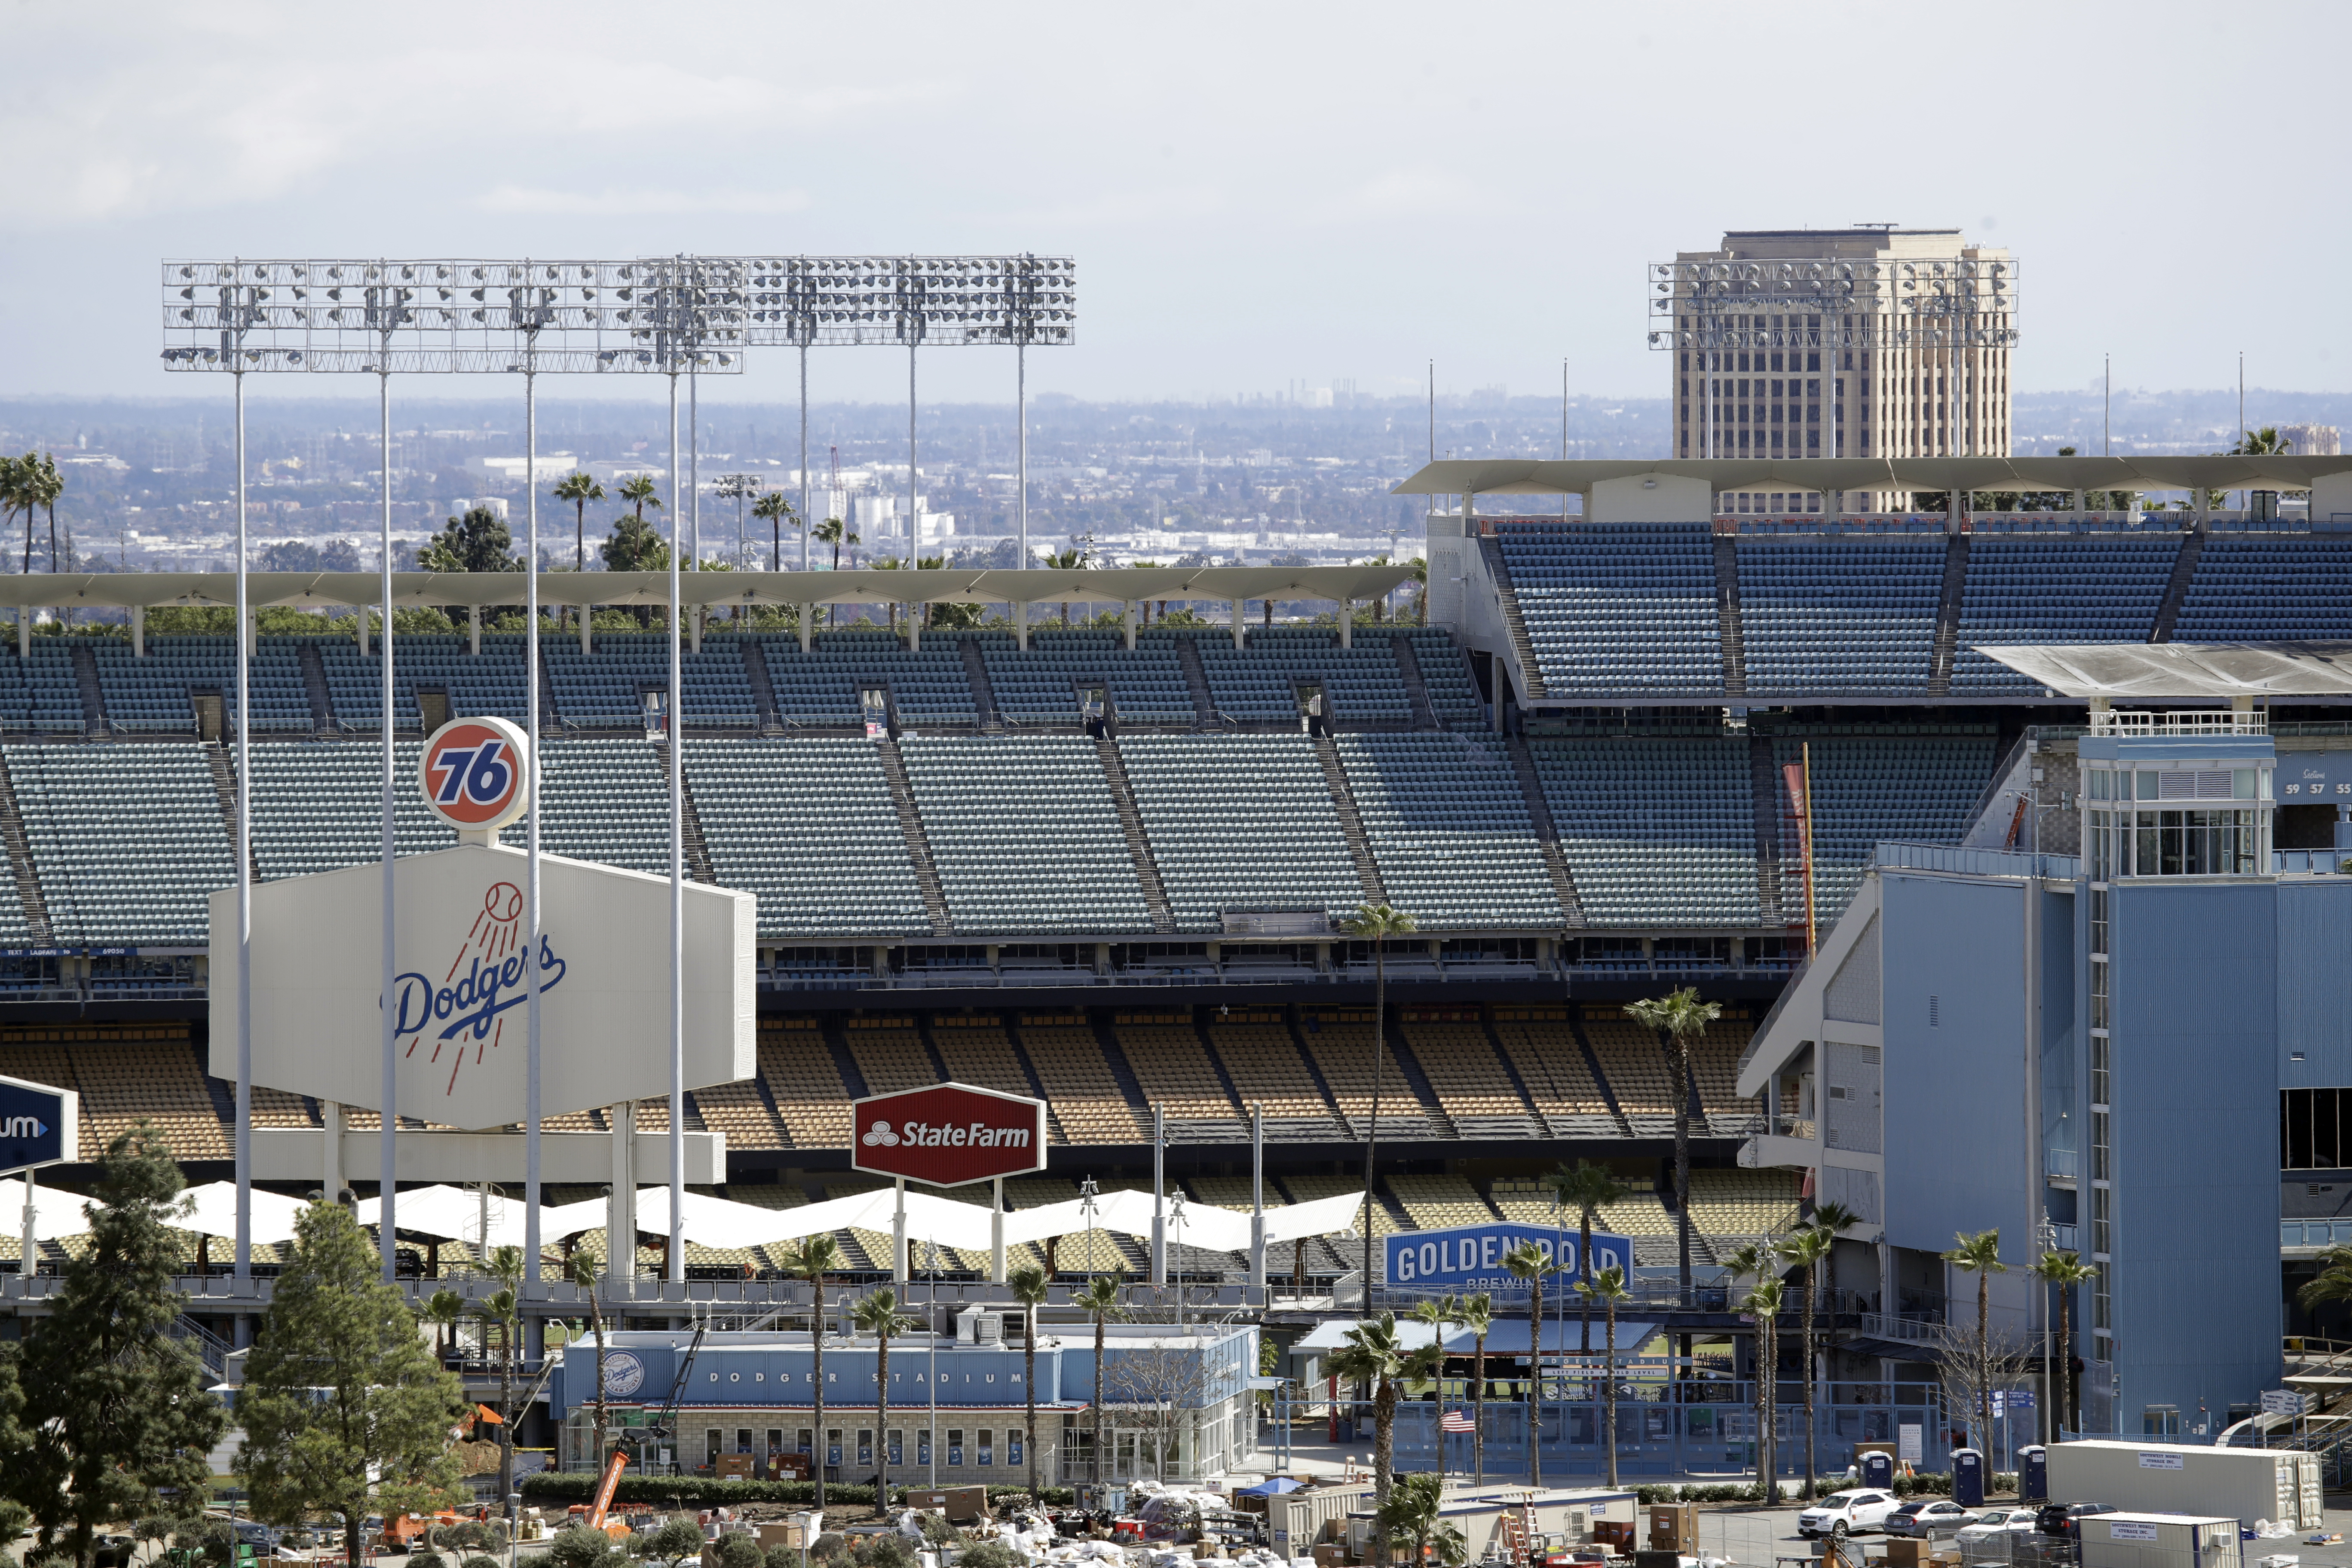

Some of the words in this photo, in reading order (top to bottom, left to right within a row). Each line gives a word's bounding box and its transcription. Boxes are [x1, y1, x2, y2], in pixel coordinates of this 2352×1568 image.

[431, 739, 512, 805] 76
[2285, 784, 2300, 794] 59
[2309, 784, 2325, 794] 57
[2336, 784, 2351, 794] 55
[1397, 1236, 1521, 1281] GOLDEN
[1467, 1277, 1549, 1289] BREWING
[606, 1355, 631, 1366] OFFICIAL
[603, 1363, 638, 1382] Dodgers
[710, 1372, 837, 1382] DODGER
[872, 1373, 1022, 1383] STADIUM
[609, 1384, 623, 1392] TEAM
[625, 1375, 640, 1391] STORE
[1561, 1385, 1589, 1393] Security
[600, 1462, 621, 1511] SKYTRAK
